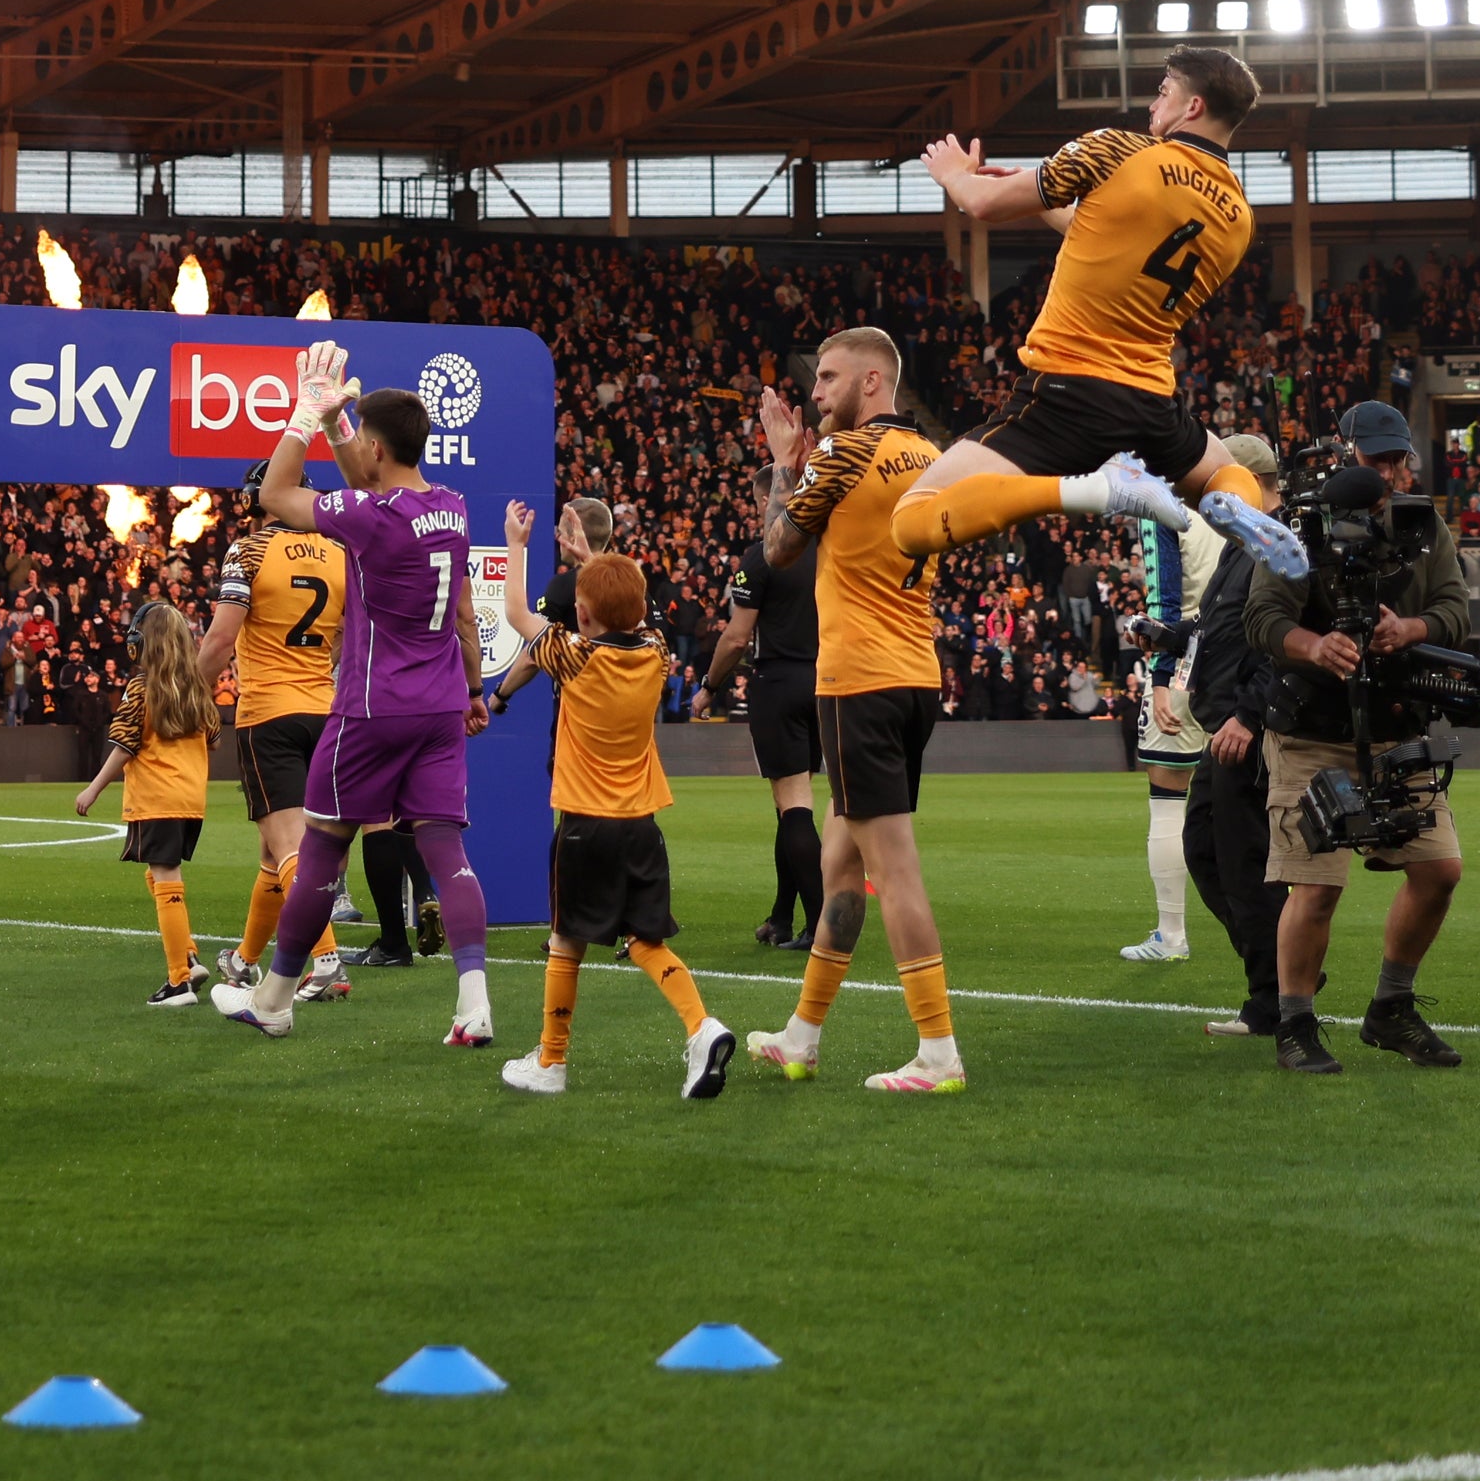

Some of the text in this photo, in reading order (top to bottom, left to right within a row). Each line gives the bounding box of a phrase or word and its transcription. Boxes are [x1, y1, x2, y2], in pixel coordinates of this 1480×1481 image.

[1158, 164, 1243, 222] HUGHES
[1140, 218, 1207, 312] 4
[9, 343, 293, 449] sky be
[424, 434, 476, 465] EFL
[411, 510, 466, 538] PANDUR
[285, 542, 327, 563] COYLE
[486, 558, 507, 576] be
[285, 575, 329, 647] 2
[428, 551, 451, 631] 1
[481, 647, 497, 662] FL
